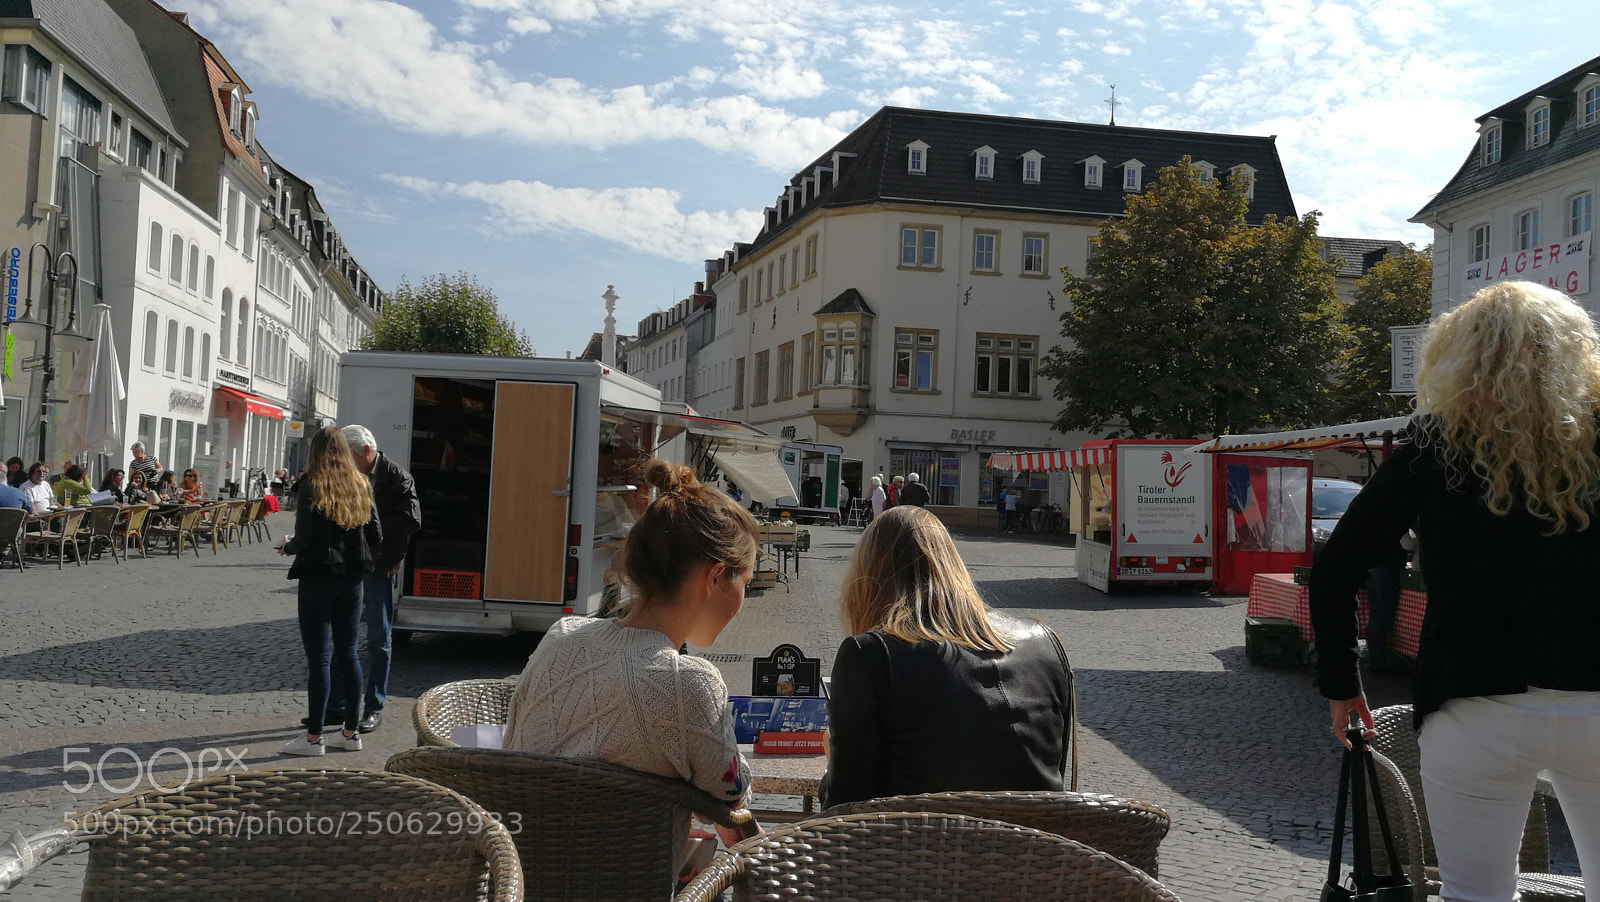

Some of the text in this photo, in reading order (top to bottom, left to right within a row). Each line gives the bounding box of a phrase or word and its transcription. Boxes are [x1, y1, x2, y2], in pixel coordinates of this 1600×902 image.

[1485, 244, 1561, 280] LAGER
[392, 422, 407, 431] seit
[950, 428, 996, 442] BASLER
[1138, 485, 1166, 494] Tiroler
[1138, 495, 1195, 504] Bauernstandl
